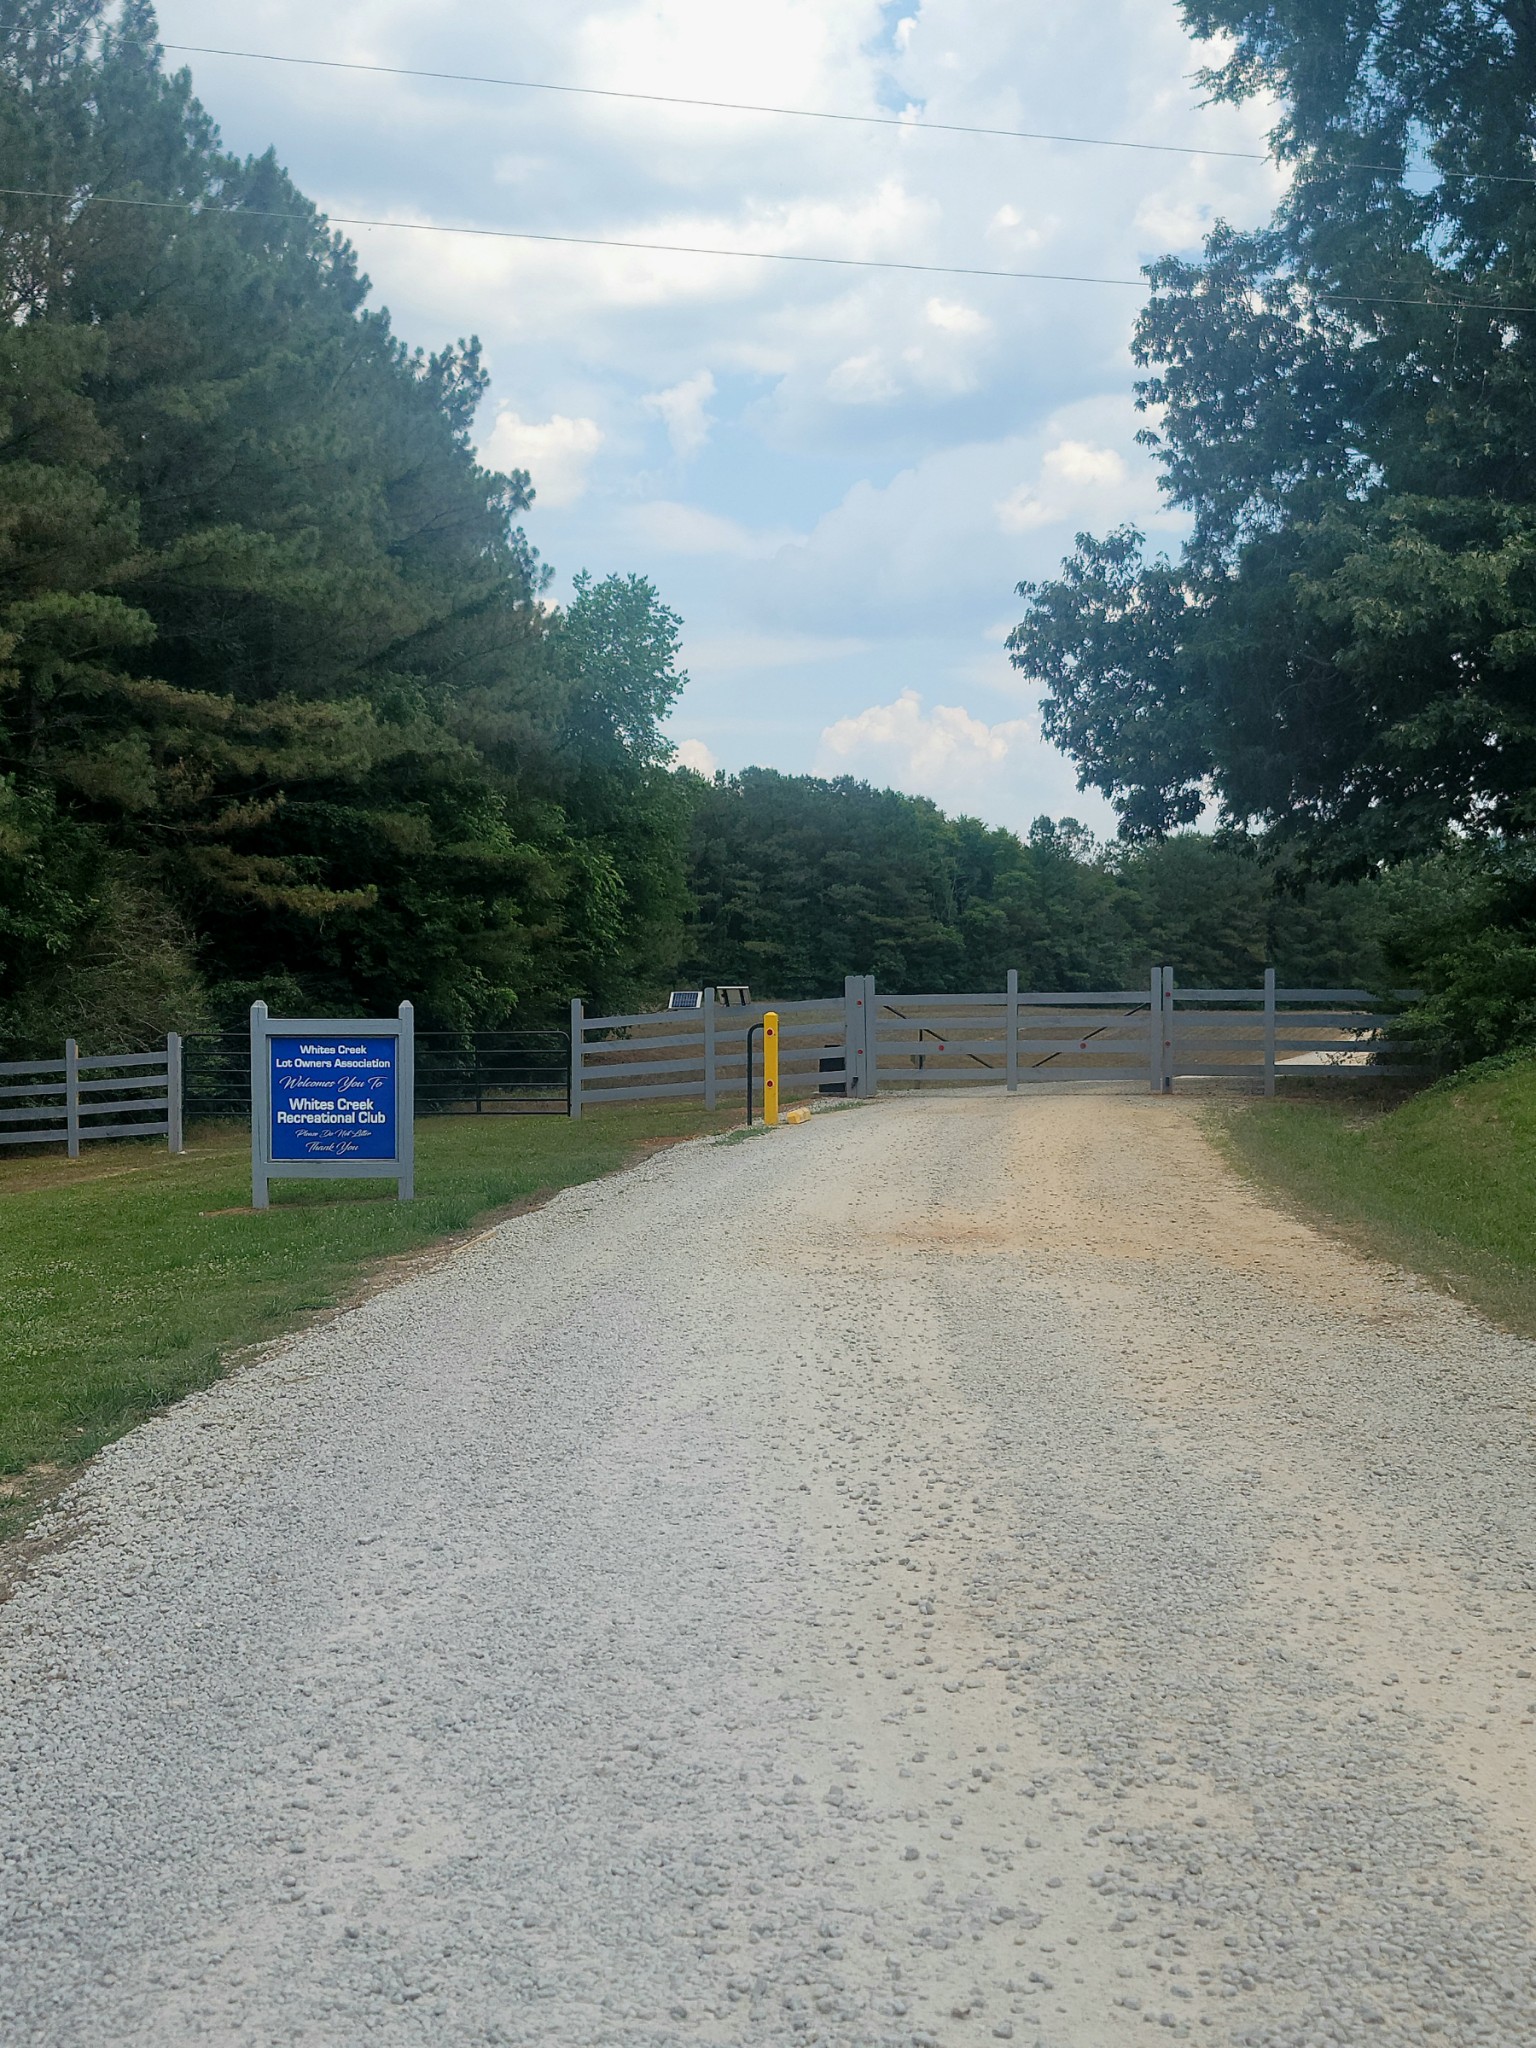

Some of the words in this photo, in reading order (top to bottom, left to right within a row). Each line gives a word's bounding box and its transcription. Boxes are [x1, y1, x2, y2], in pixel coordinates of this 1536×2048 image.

[300, 1045, 335, 1054] Whites
[338, 1045, 367, 1054] Creek
[276, 1059, 292, 1068] Lot
[294, 1059, 331, 1068] Owners
[334, 1059, 390, 1068] Association
[279, 1076, 335, 1089] Welcomes
[338, 1076, 364, 1092] You
[368, 1076, 388, 1090] To
[289, 1098, 334, 1110] Whites
[337, 1098, 374, 1110] Creek
[277, 1112, 355, 1123] Recreational
[359, 1112, 385, 1123] Club
[295, 1130, 318, 1138] Please
[319, 1130, 334, 1138] Do
[306, 1142, 335, 1152] Thank
[336, 1142, 359, 1155] You
